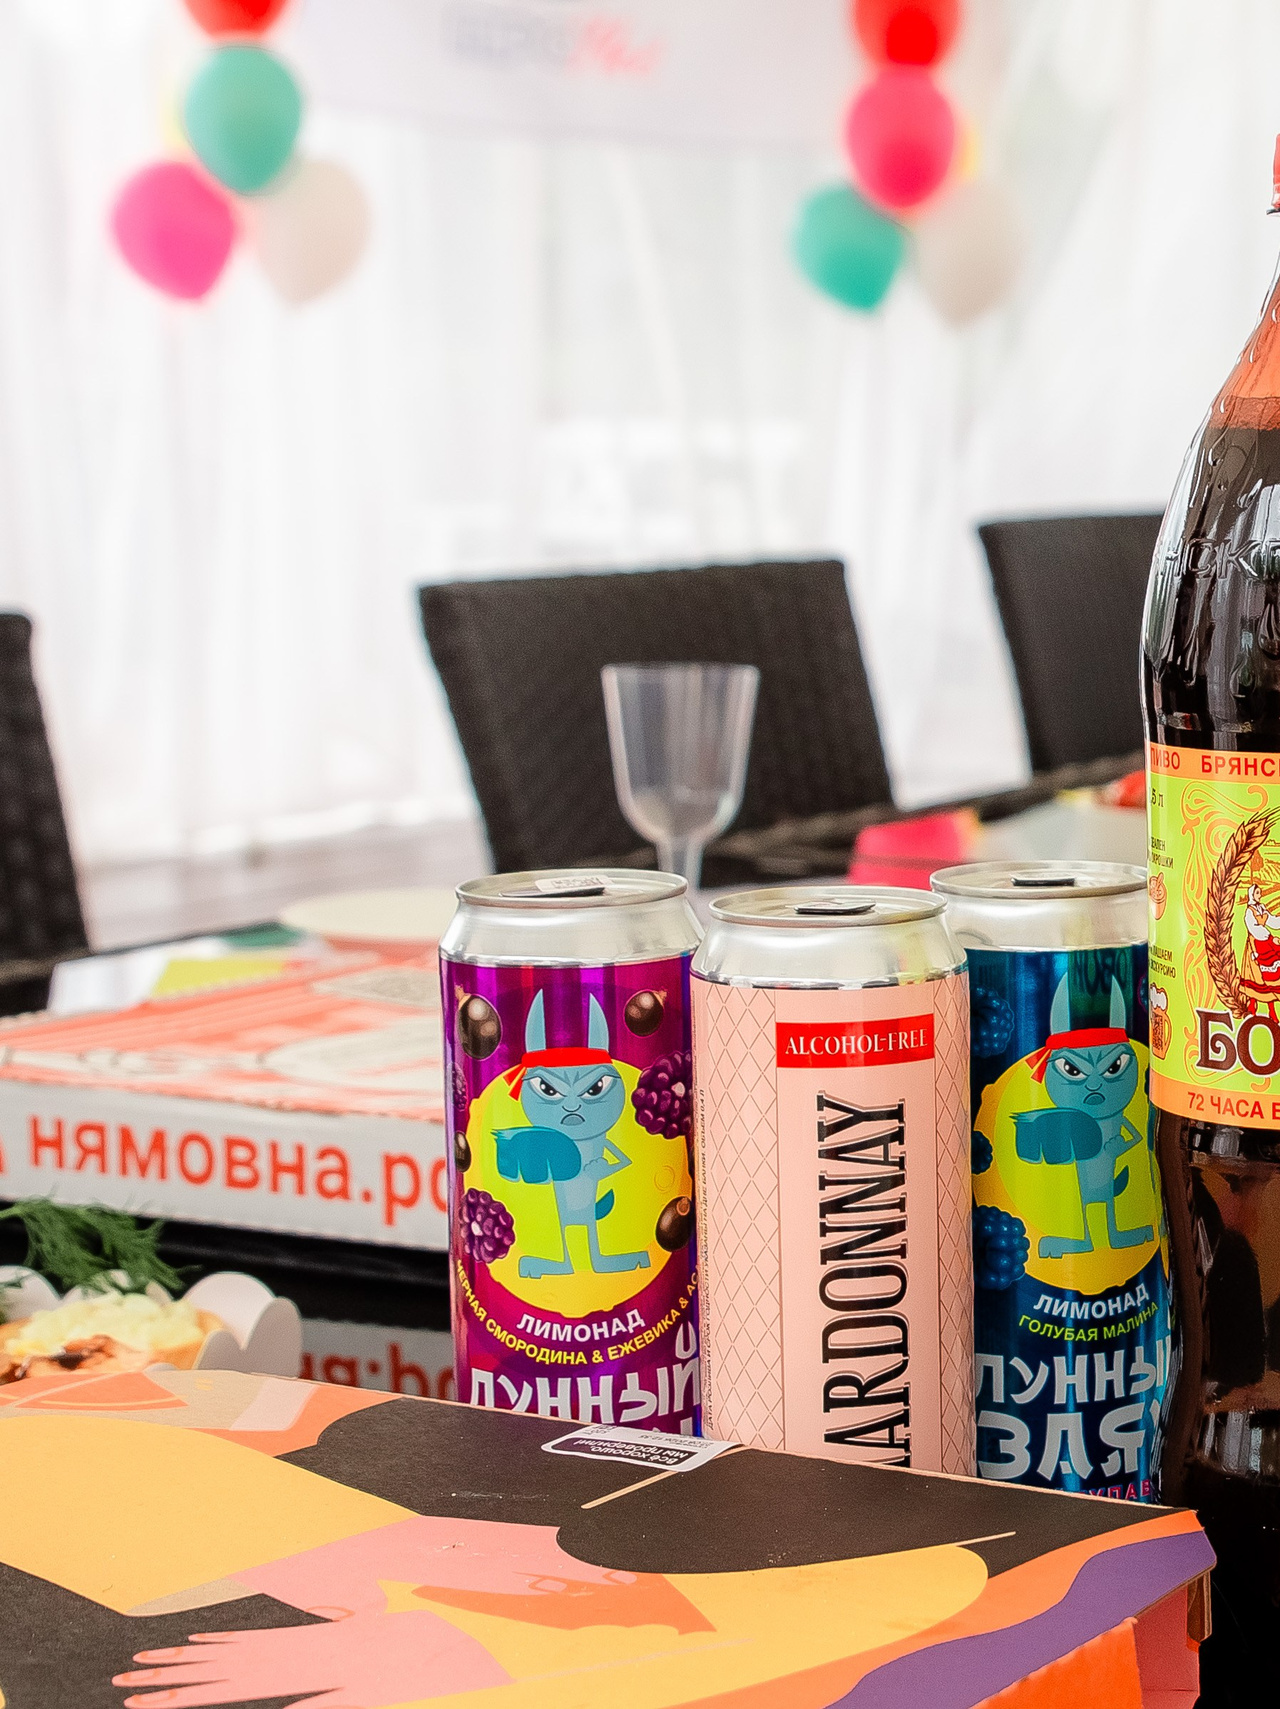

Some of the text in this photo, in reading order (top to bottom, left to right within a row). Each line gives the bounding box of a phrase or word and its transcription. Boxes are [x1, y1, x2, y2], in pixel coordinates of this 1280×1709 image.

[1150, 747, 1181, 771] ПИВО
[785, 1027, 928, 1057] ALCOHOL-FREE
[1187, 1091, 1205, 1112] 72
[1210, 1095, 1265, 1119] ЧАСА
[1033, 1283, 1150, 1320] ЛИМОНАД
[485, 1318, 588, 1365] СМОРОДИНА
[592, 1349, 604, 1363] &
[607, 1308, 682, 1360] ЕЖЕВИКА
[516, 1308, 646, 1342] ЛИМОНАД
[1019, 1301, 1160, 1342] ГОЛУБАЯ МАЛИНА
